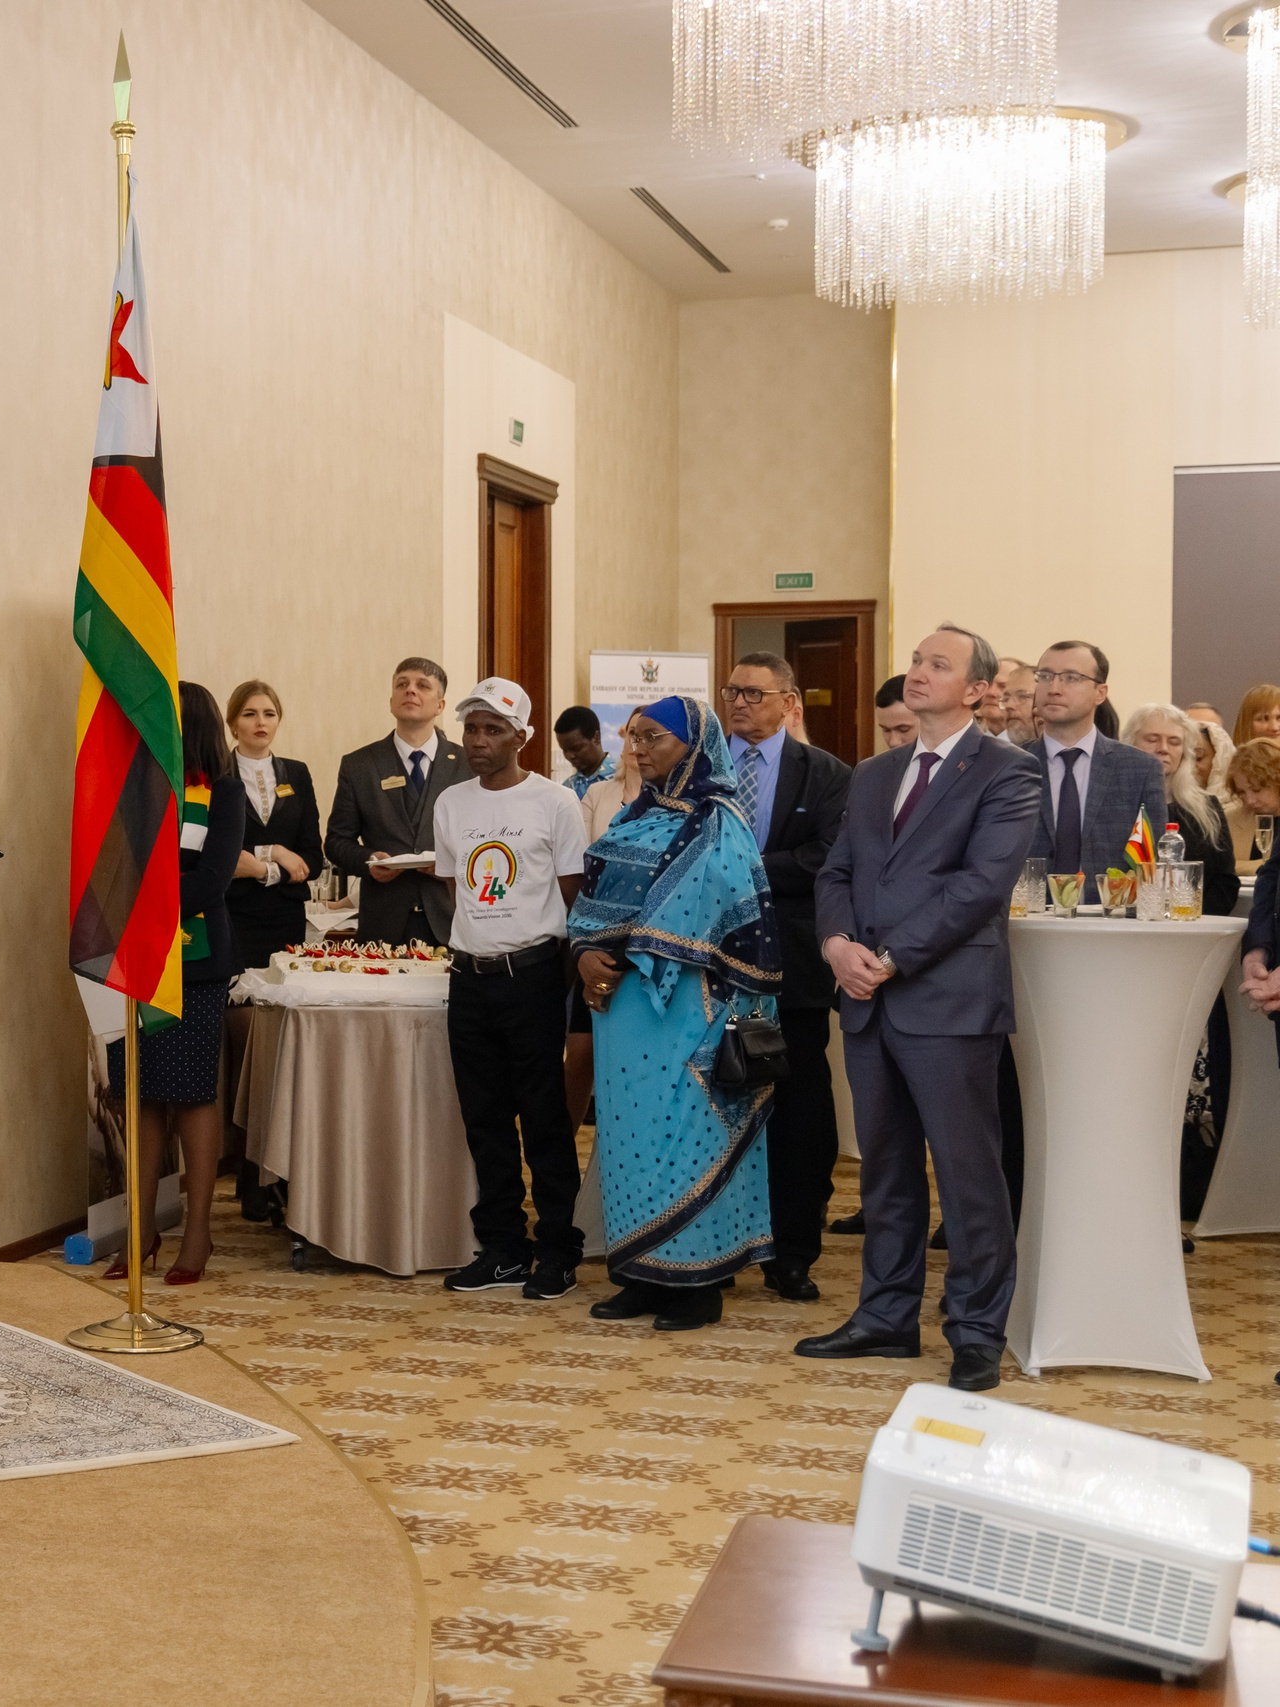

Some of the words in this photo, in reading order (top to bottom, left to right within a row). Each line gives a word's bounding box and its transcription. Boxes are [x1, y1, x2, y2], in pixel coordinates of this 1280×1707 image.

[778, 576, 809, 586] EXIT
[462, 828, 486, 840] Zim
[488, 825, 524, 838] Minsk
